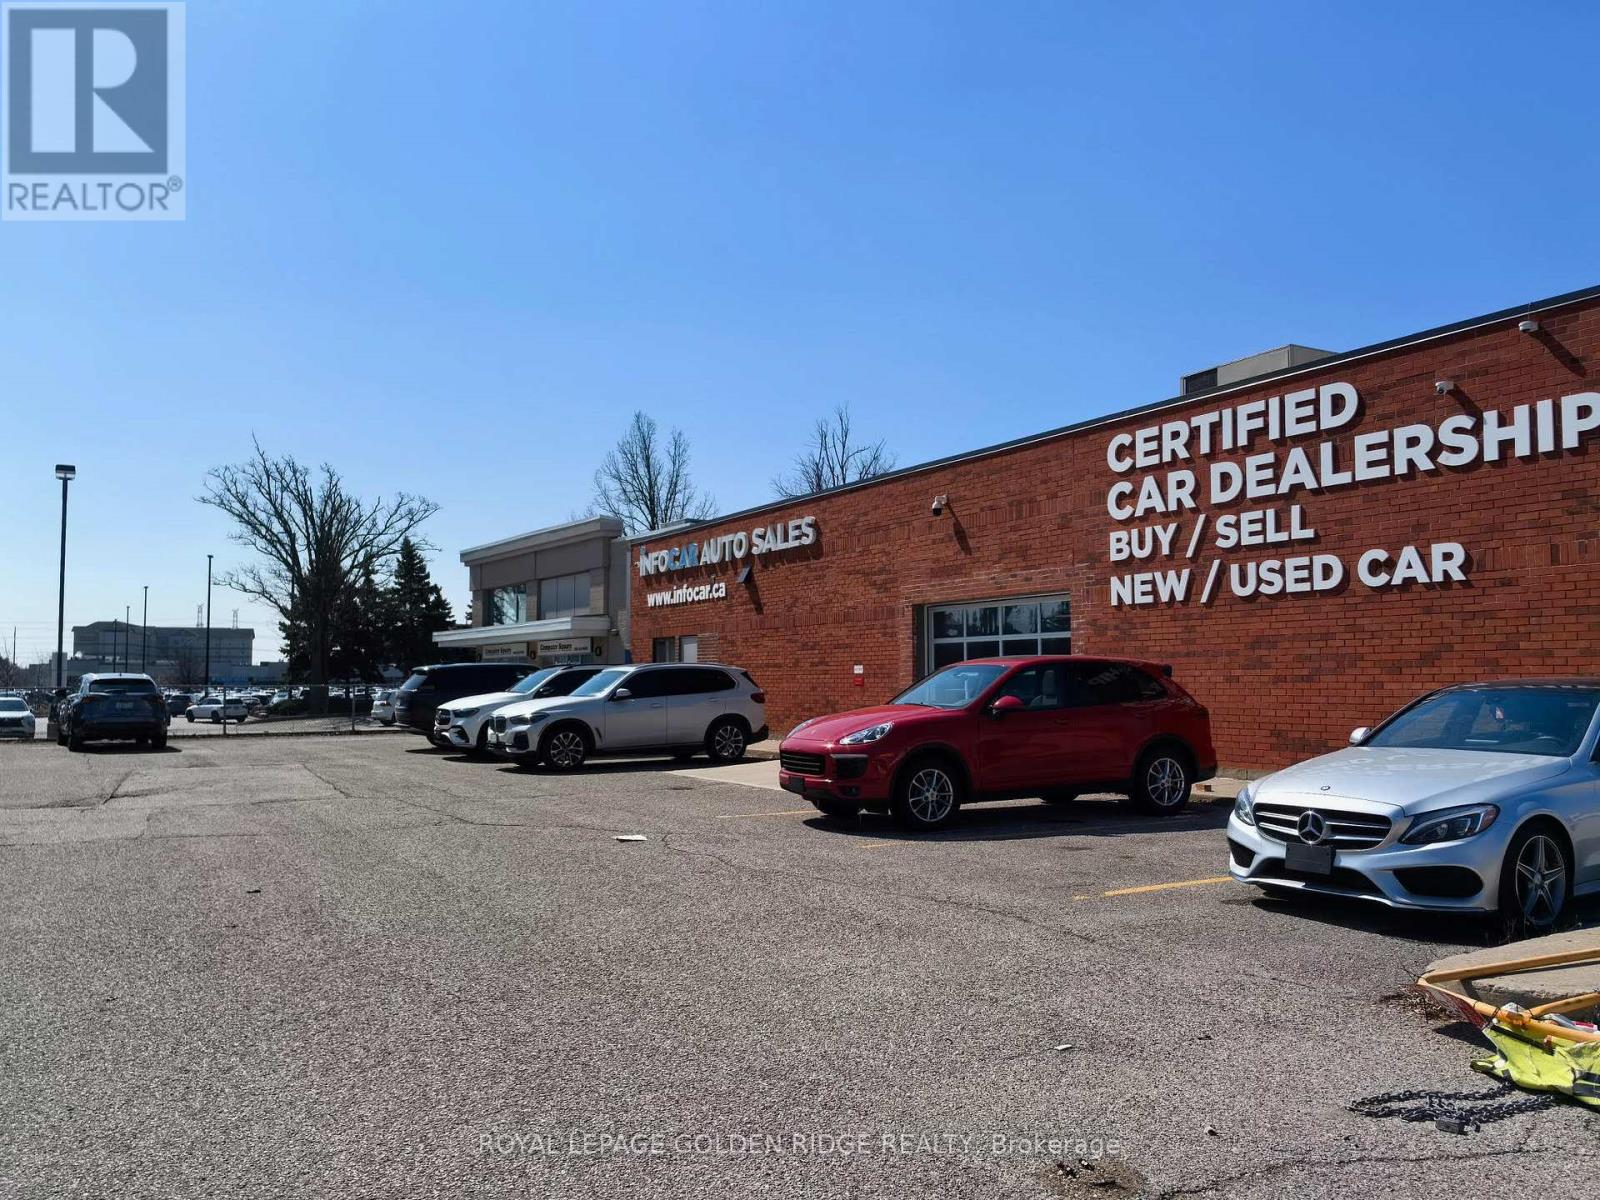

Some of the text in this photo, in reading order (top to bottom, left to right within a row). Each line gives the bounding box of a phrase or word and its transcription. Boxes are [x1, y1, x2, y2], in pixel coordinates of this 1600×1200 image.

[1107, 382, 1358, 473] CERTIFIED
[1107, 392, 1600, 521] CAR DEALERSHIP
[700, 532, 748, 565] AUTO
[752, 516, 818, 555] SALES
[1109, 523, 1179, 562] BUY
[1215, 504, 1315, 549] SELL
[647, 582, 726, 607] www.infocar.ca
[1110, 568, 1191, 606] NEW
[1230, 554, 1344, 597] USED
[1357, 542, 1467, 588] CAR
